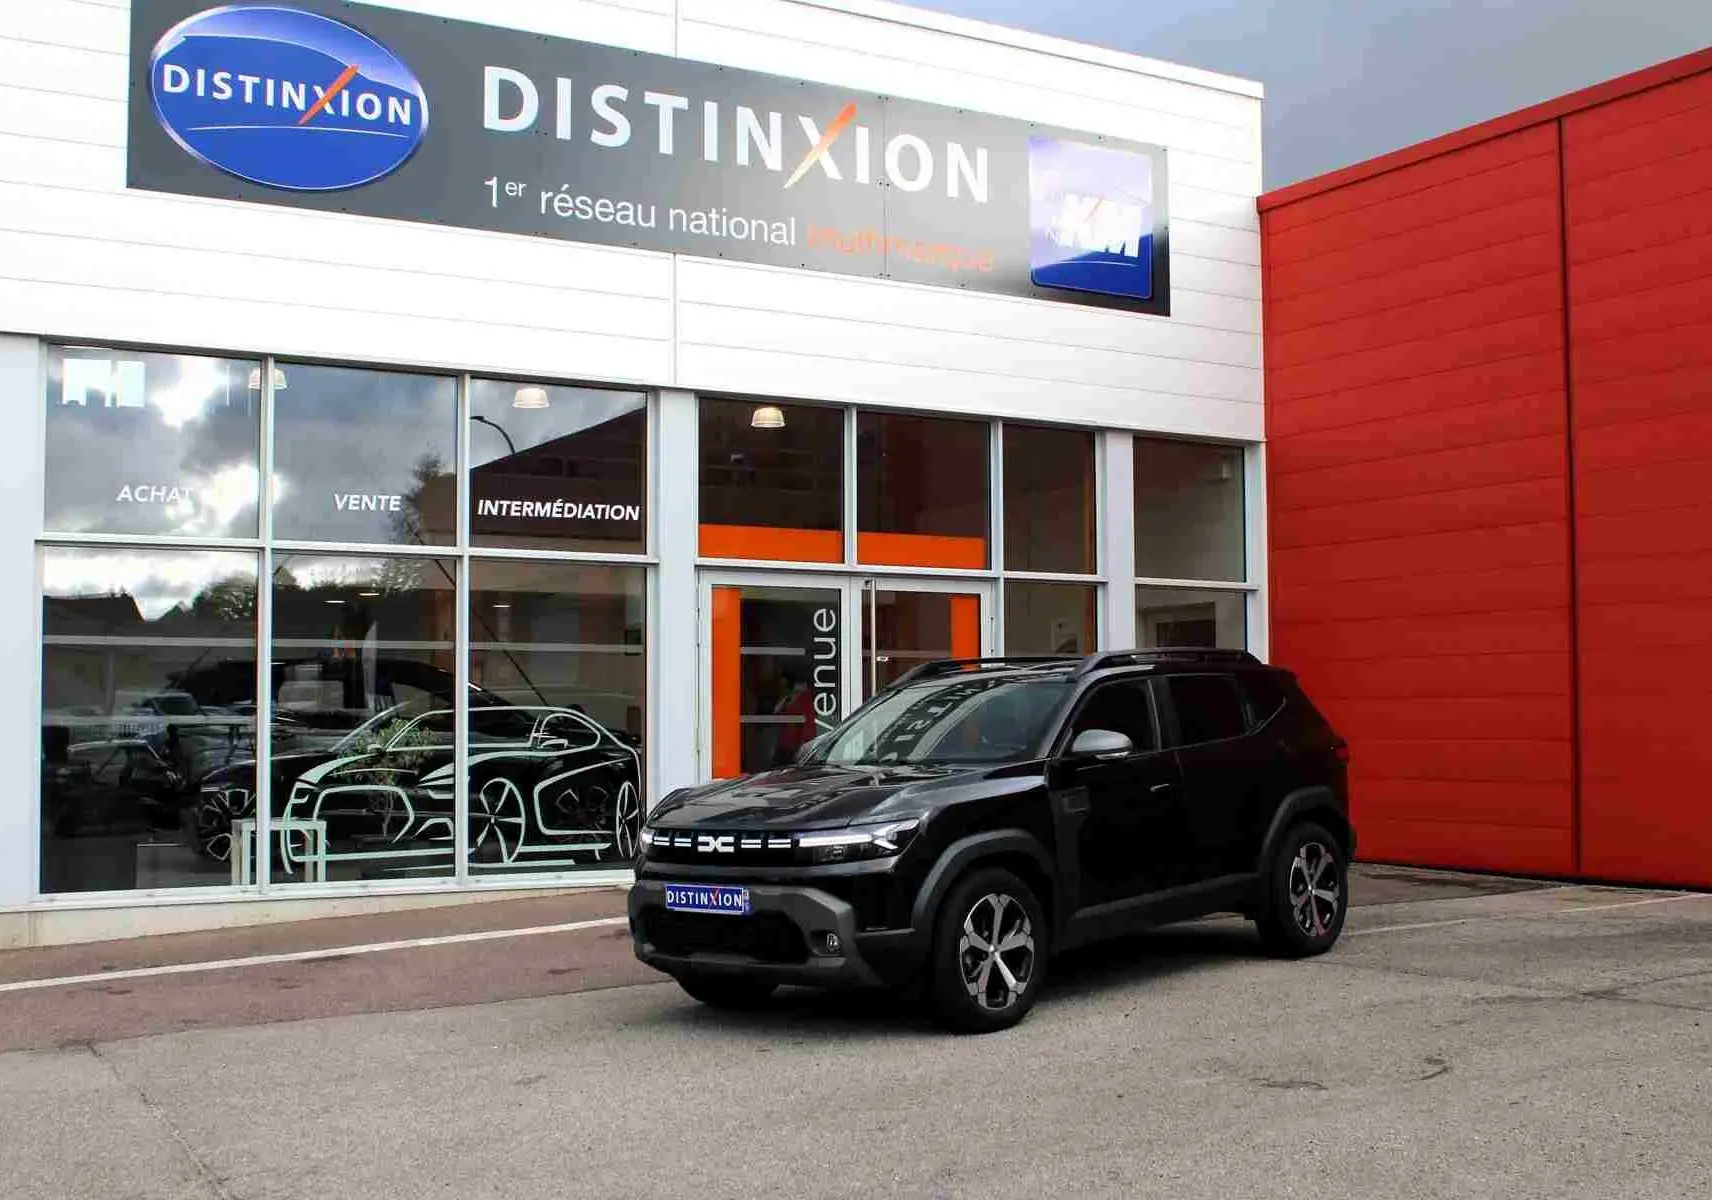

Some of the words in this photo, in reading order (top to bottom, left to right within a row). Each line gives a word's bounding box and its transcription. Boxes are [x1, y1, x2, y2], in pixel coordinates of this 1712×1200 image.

[162, 64, 412, 126] DISTINXION
[482, 65, 989, 204] DISTINXION
[540, 184, 656, 228] réseau
[669, 207, 796, 246] national
[115, 484, 194, 503] ACHAT
[333, 493, 402, 512] VENTE
[476, 498, 641, 521] INTERMÉDIATION
[666, 888, 743, 908] DISTINXION
